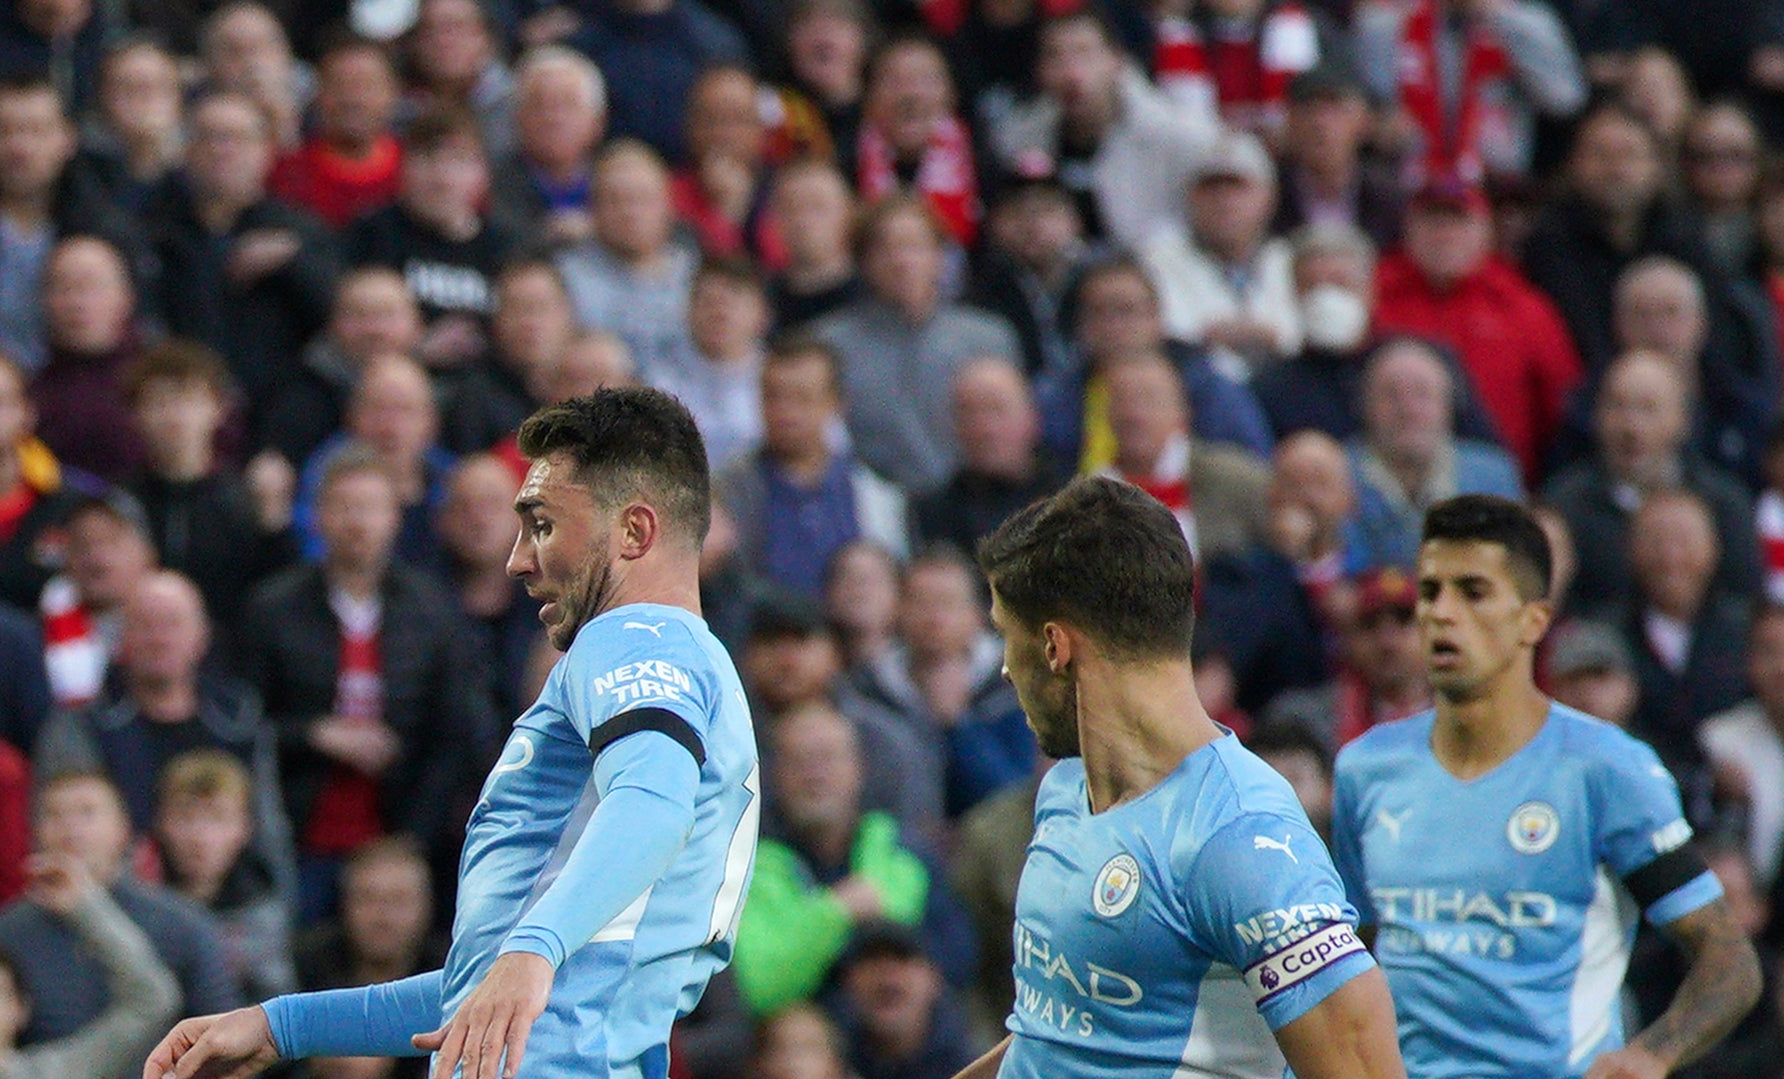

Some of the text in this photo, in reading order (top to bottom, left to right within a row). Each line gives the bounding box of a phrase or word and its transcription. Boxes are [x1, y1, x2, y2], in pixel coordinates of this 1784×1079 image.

[594, 660, 690, 695] NEXEN
[611, 679, 681, 703] TIRE
[1234, 902, 1342, 946] NEXEN
